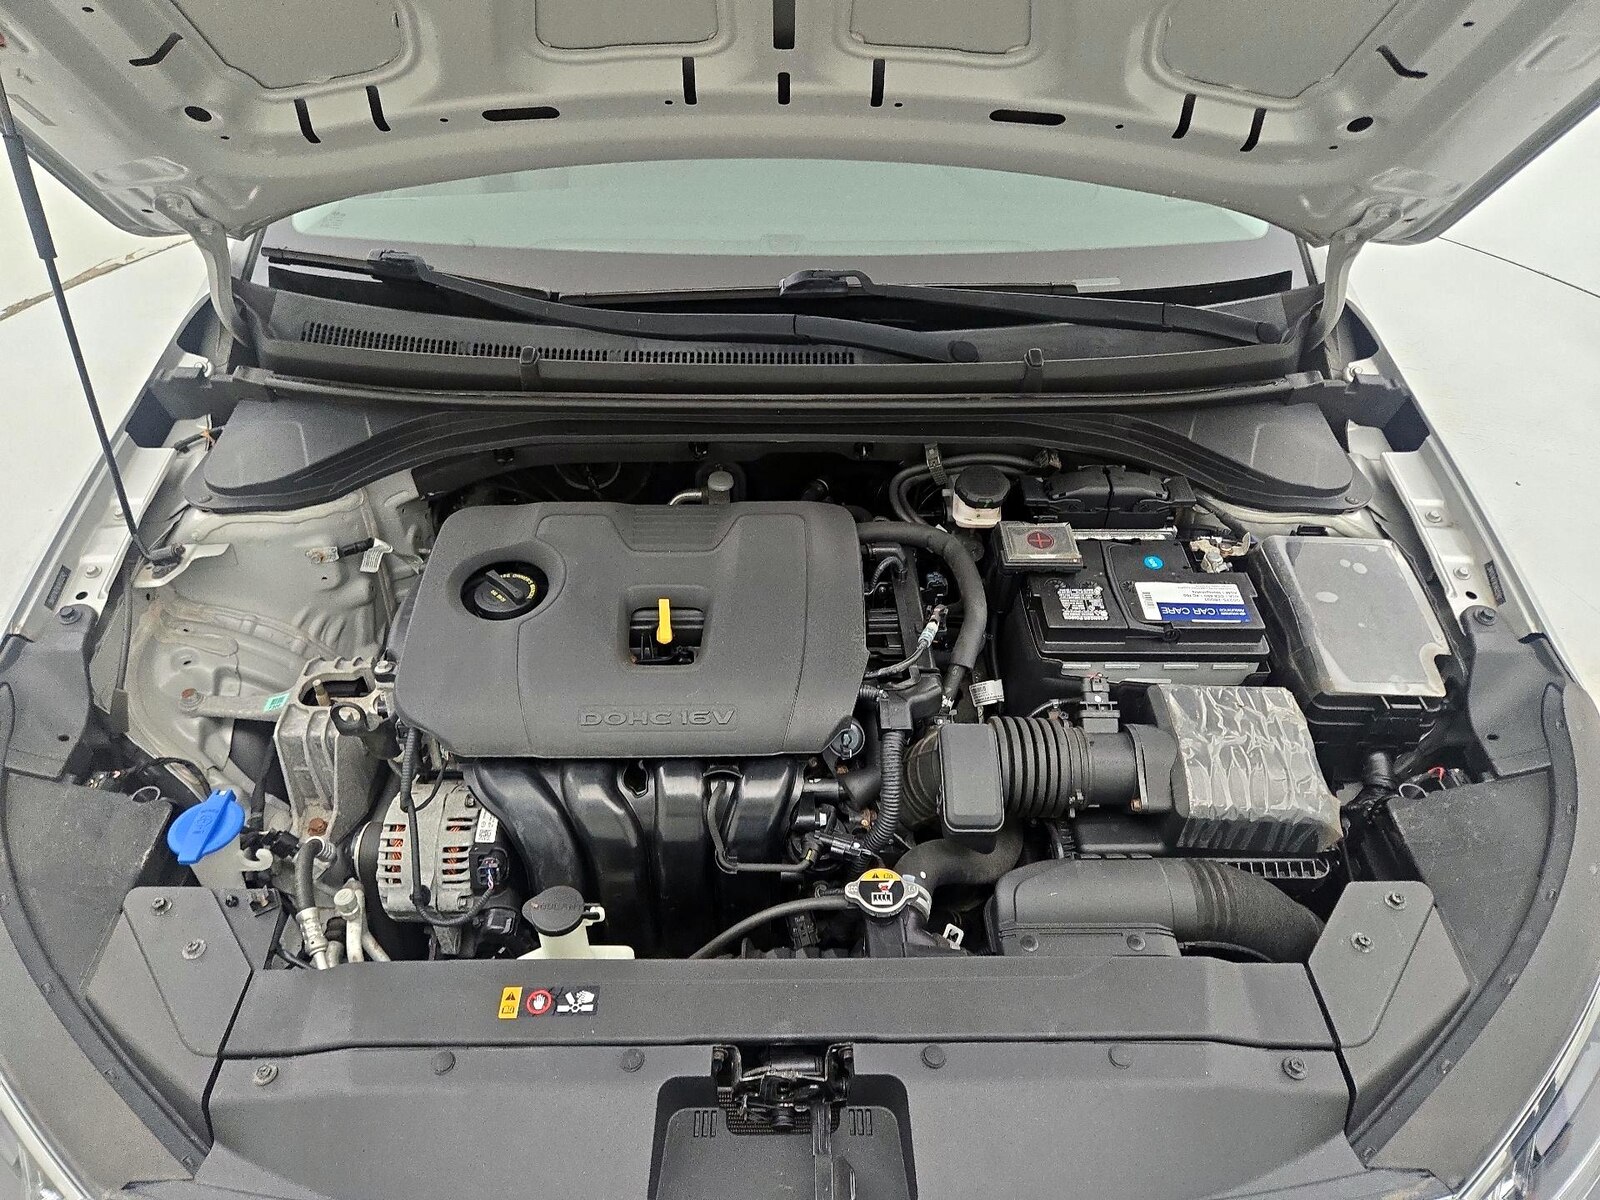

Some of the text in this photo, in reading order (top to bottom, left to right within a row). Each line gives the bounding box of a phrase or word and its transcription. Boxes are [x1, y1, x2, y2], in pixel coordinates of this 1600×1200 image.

[1160, 606, 1191, 615] CARE
[1193, 607, 1216, 615] CAR
[580, 708, 735, 726] DOHC 16V
